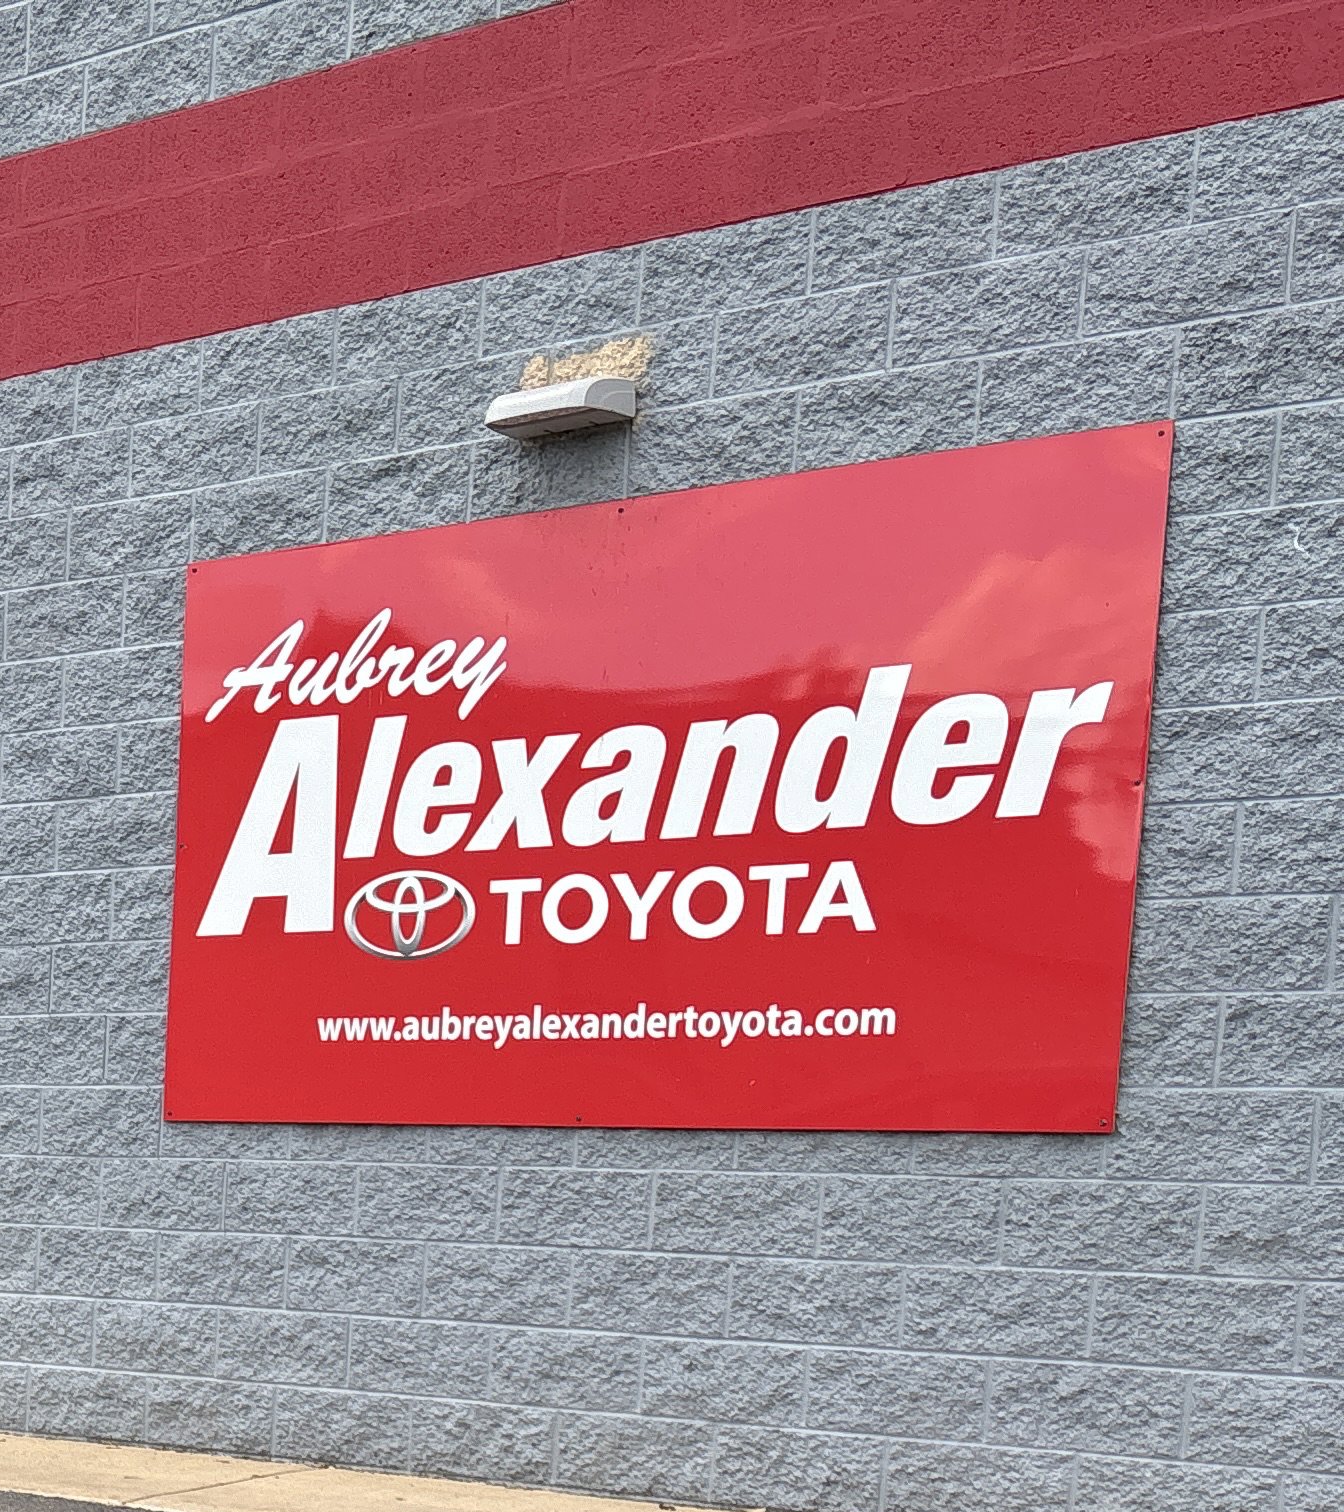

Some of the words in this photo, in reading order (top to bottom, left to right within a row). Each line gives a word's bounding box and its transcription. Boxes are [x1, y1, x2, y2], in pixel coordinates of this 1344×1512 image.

[204, 607, 507, 722] Aubrey
[195, 663, 1115, 937] Alexander
[489, 860, 877, 945] TOYOTA
[317, 1002, 896, 1050] www.aubreyalexandertoyota.com
